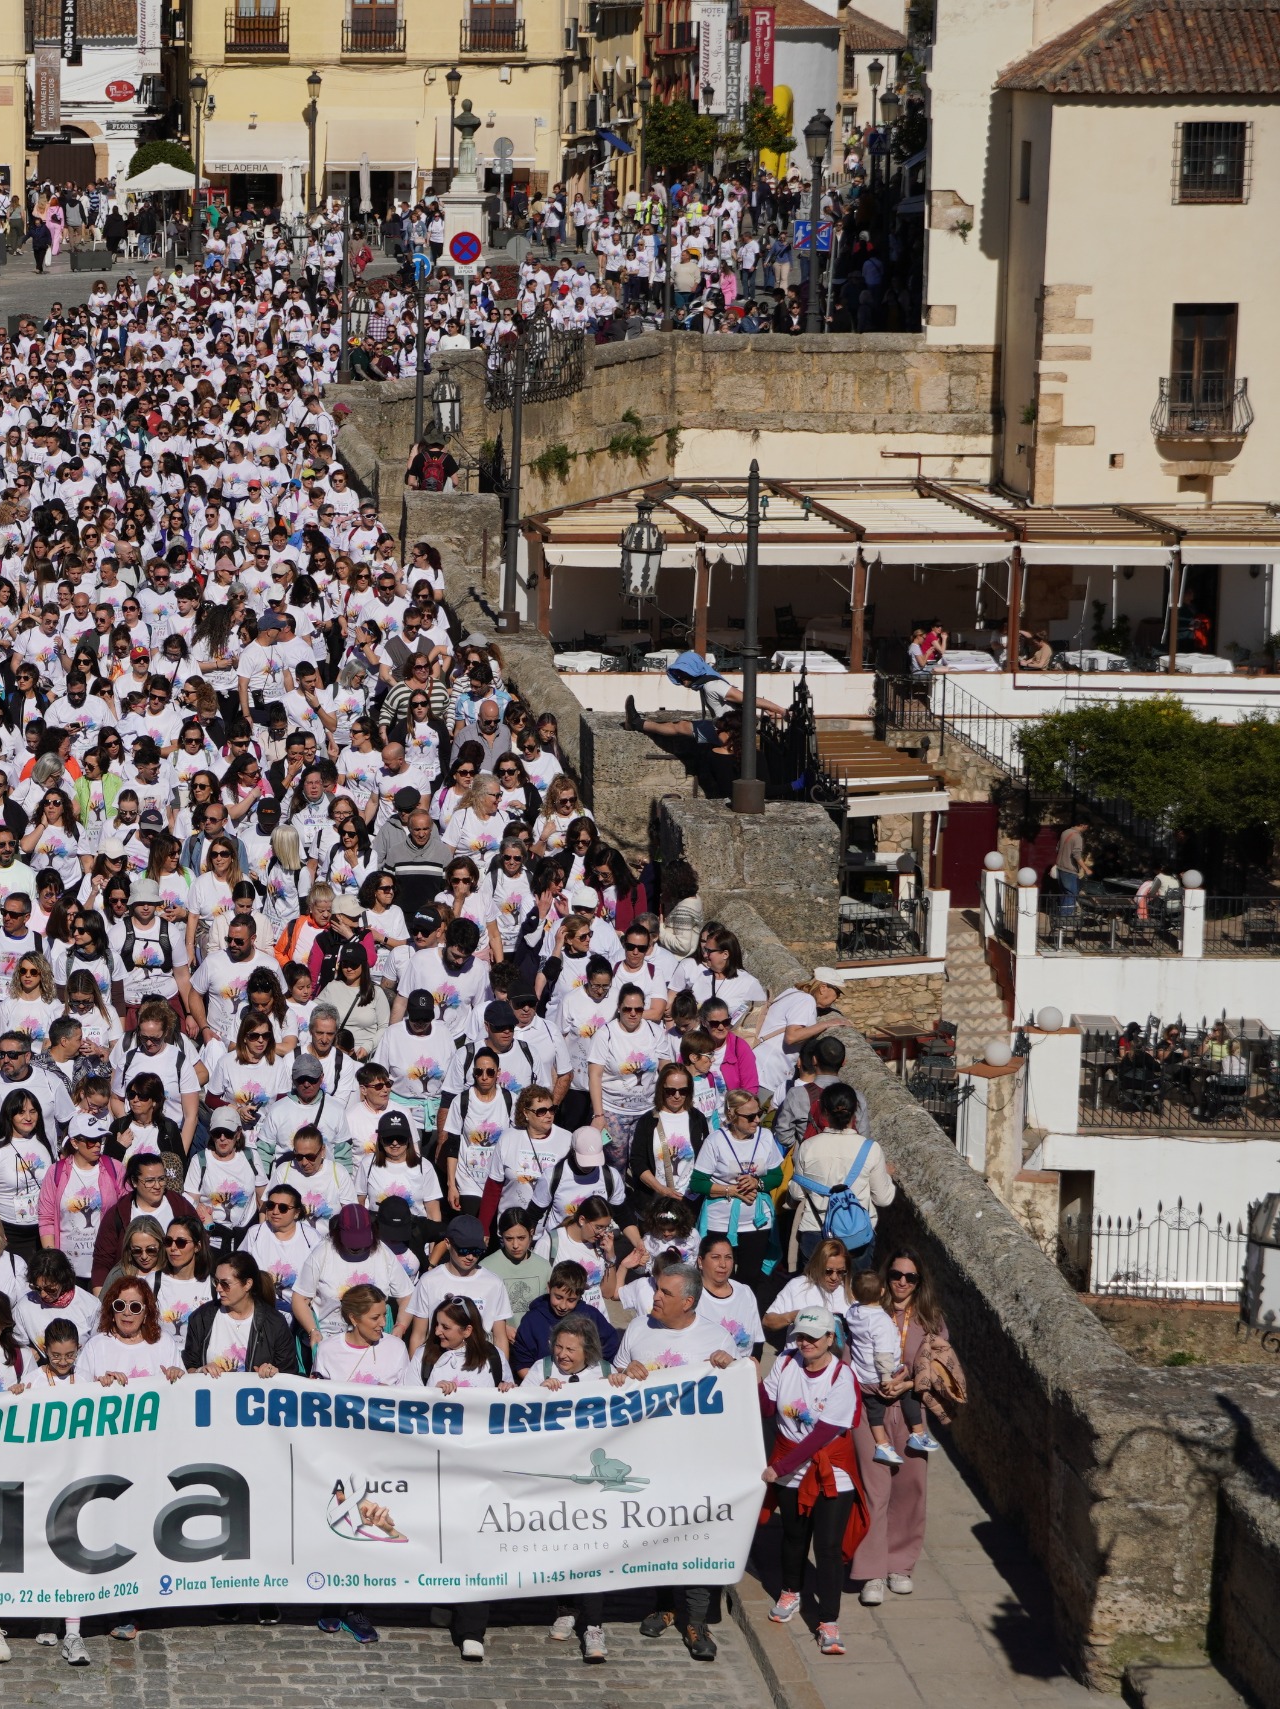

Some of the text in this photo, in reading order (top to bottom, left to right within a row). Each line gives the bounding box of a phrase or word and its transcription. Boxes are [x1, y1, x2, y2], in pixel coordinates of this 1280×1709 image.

[214, 164, 269, 172] HELADERIA
[195, 1375, 724, 1436] I CARRERA INFANTIL
[477, 1495, 735, 1533] Abades Ronda
[499, 1532, 711, 1553] Restaurante & eventos
[175, 1574, 289, 1591] Plaza Teniente Arce
[326, 1574, 360, 1587] 10:30
[363, 1574, 397, 1587] horas
[417, 1573, 461, 1587] Carrera
[465, 1572, 508, 1587] infantil
[532, 1570, 565, 1584] 11:45
[569, 1567, 602, 1581] horas
[621, 1559, 679, 1574] Caminata
[682, 1557, 736, 1571] solidaria
[20, 1589, 33, 1603] 22
[37, 1589, 51, 1603] de
[55, 1588, 96, 1603] febrero
[98, 1585, 111, 1600] de
[113, 1581, 140, 1597] 2026
